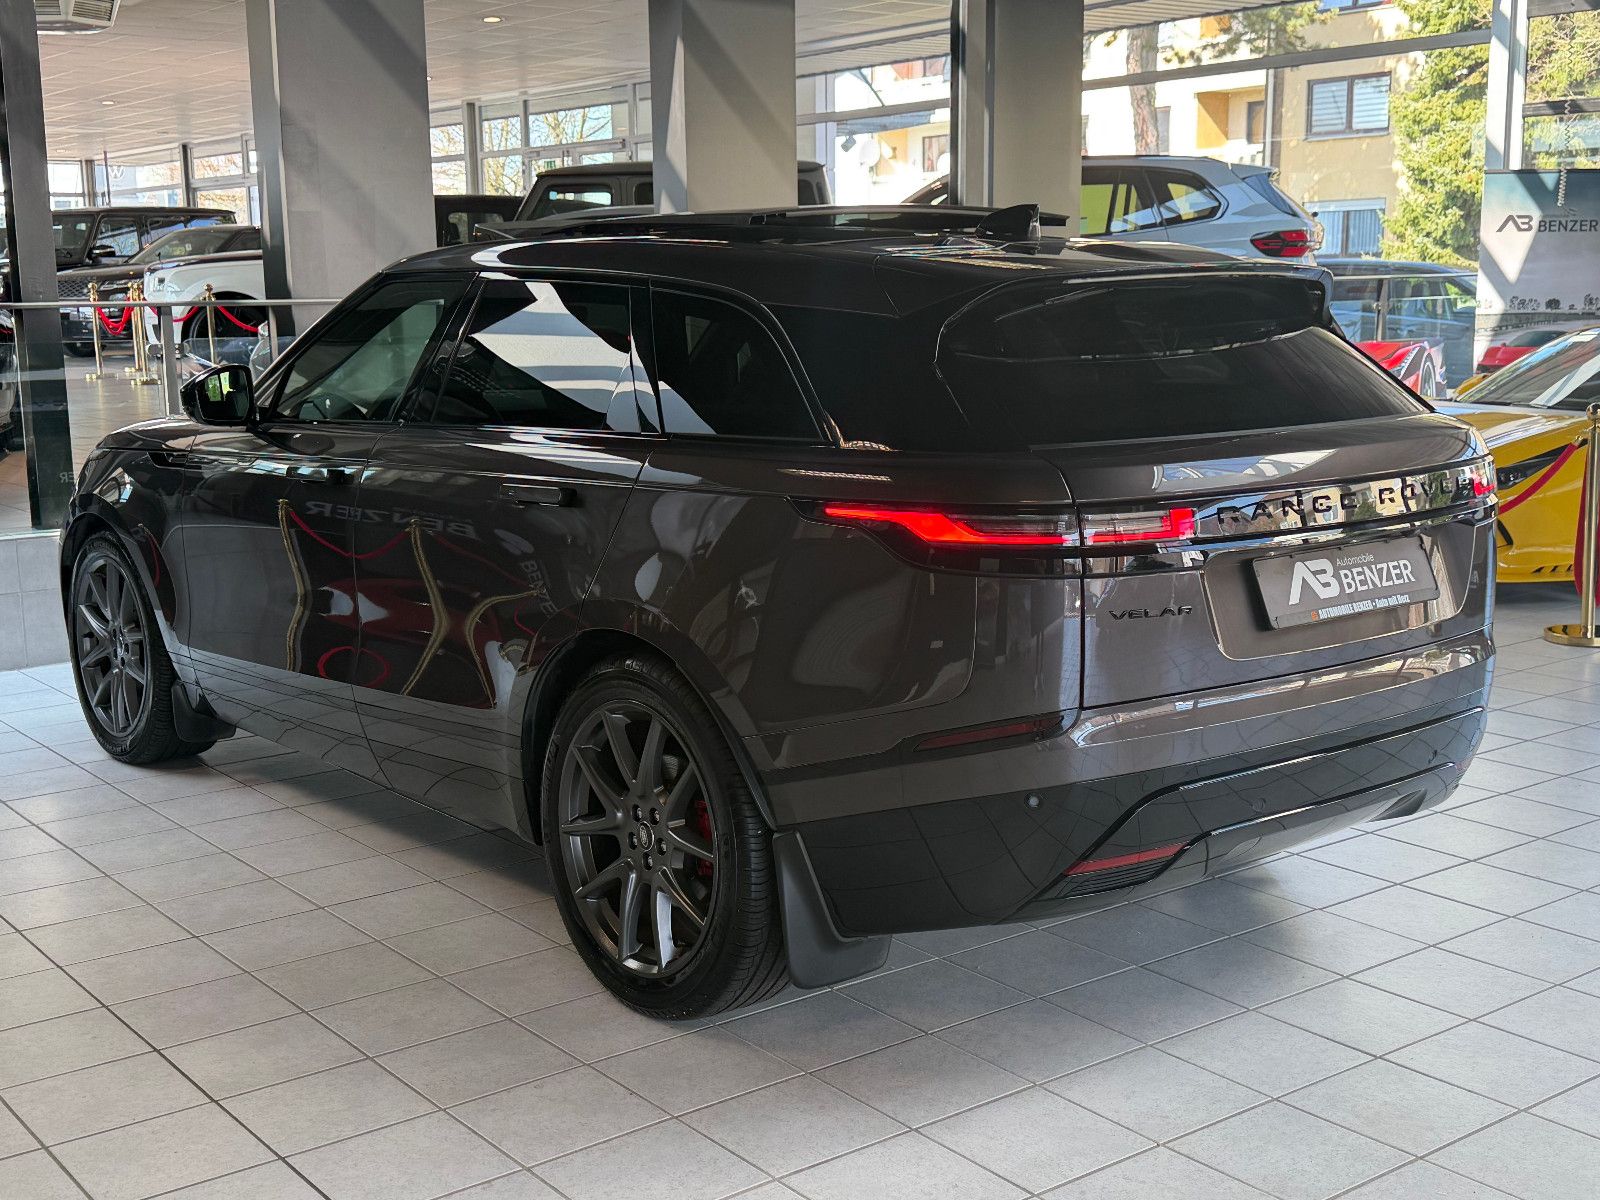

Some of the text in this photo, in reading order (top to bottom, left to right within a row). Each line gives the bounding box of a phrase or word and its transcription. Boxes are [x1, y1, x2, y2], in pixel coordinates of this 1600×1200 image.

[1538, 219, 1599, 233] BENZER
[1217, 492, 1359, 525] RANGE
[1336, 552, 1376, 567] Automobile
[1288, 558, 1416, 606] AB BENZER
[1108, 605, 1193, 621] VELAR
[1318, 603, 1354, 620] AUTOMOBILE
[1353, 600, 1374, 612] BENZER
